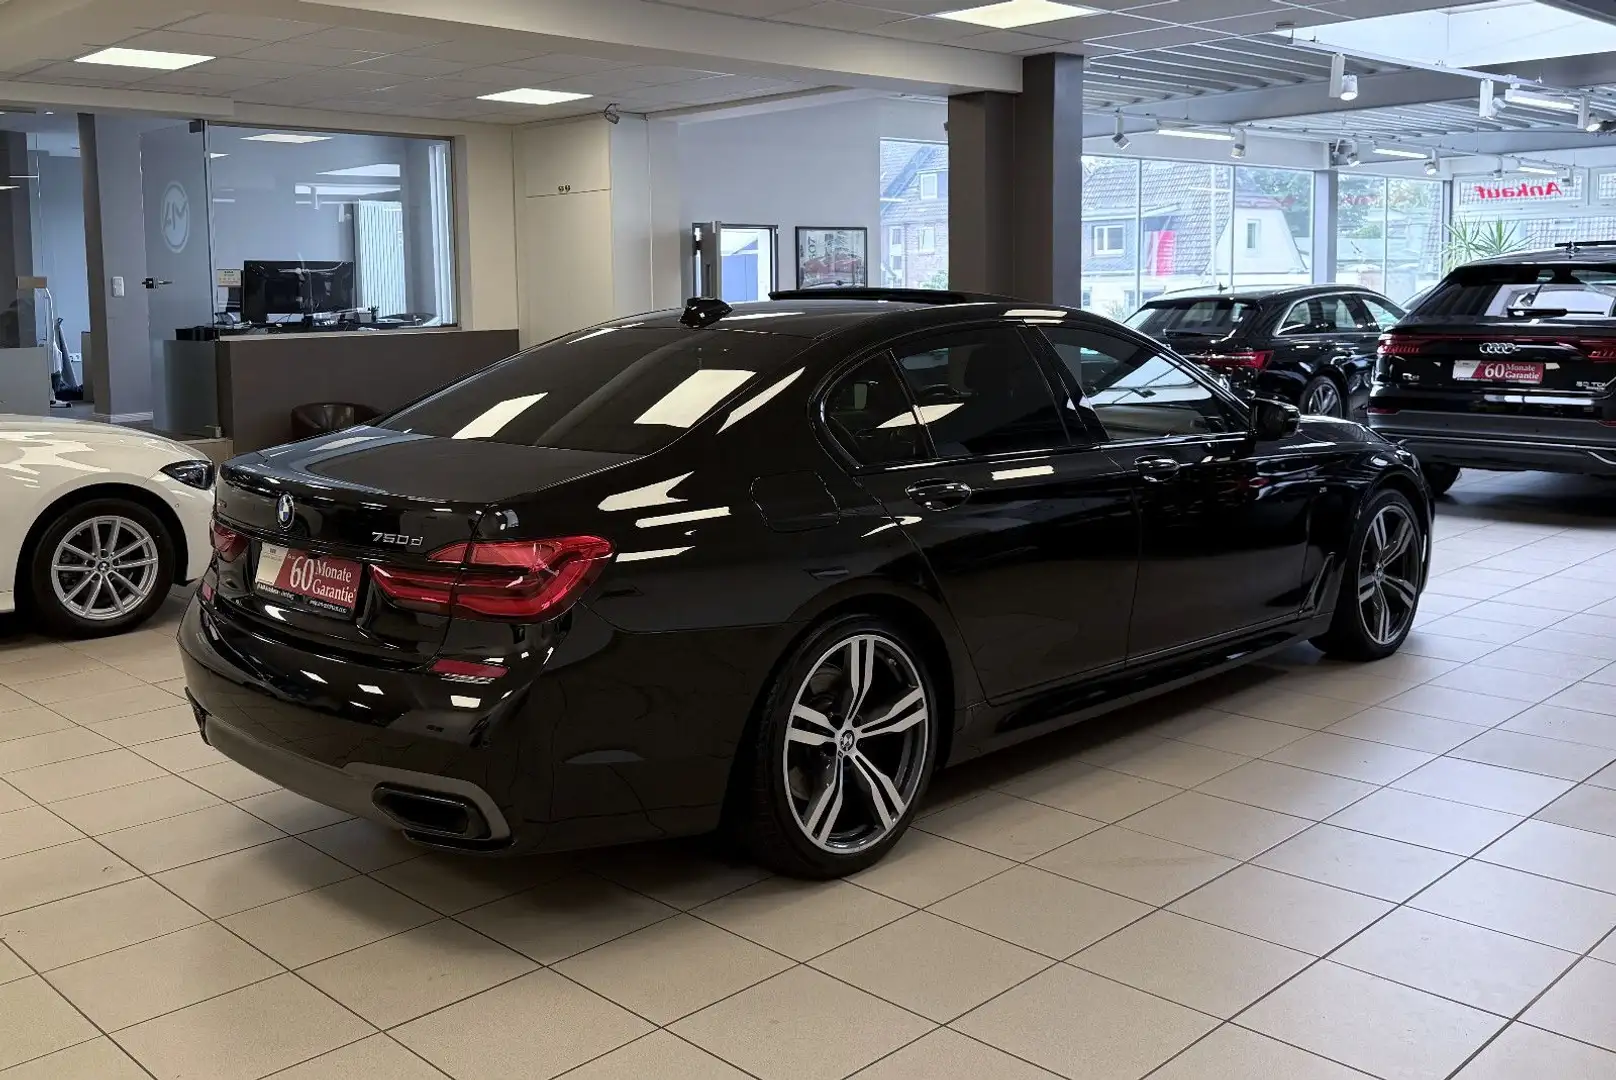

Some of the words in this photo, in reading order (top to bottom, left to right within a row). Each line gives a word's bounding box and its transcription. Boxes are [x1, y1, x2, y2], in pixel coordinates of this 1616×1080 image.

[1484, 363, 1505, 378] 60
[1505, 363, 1536, 371] Monate
[1504, 370, 1540, 380] Garantie
[371, 531, 424, 546] 750d
[289, 556, 315, 591] 60
[315, 560, 352, 583] Monate
[312, 578, 354, 603] Garantie
